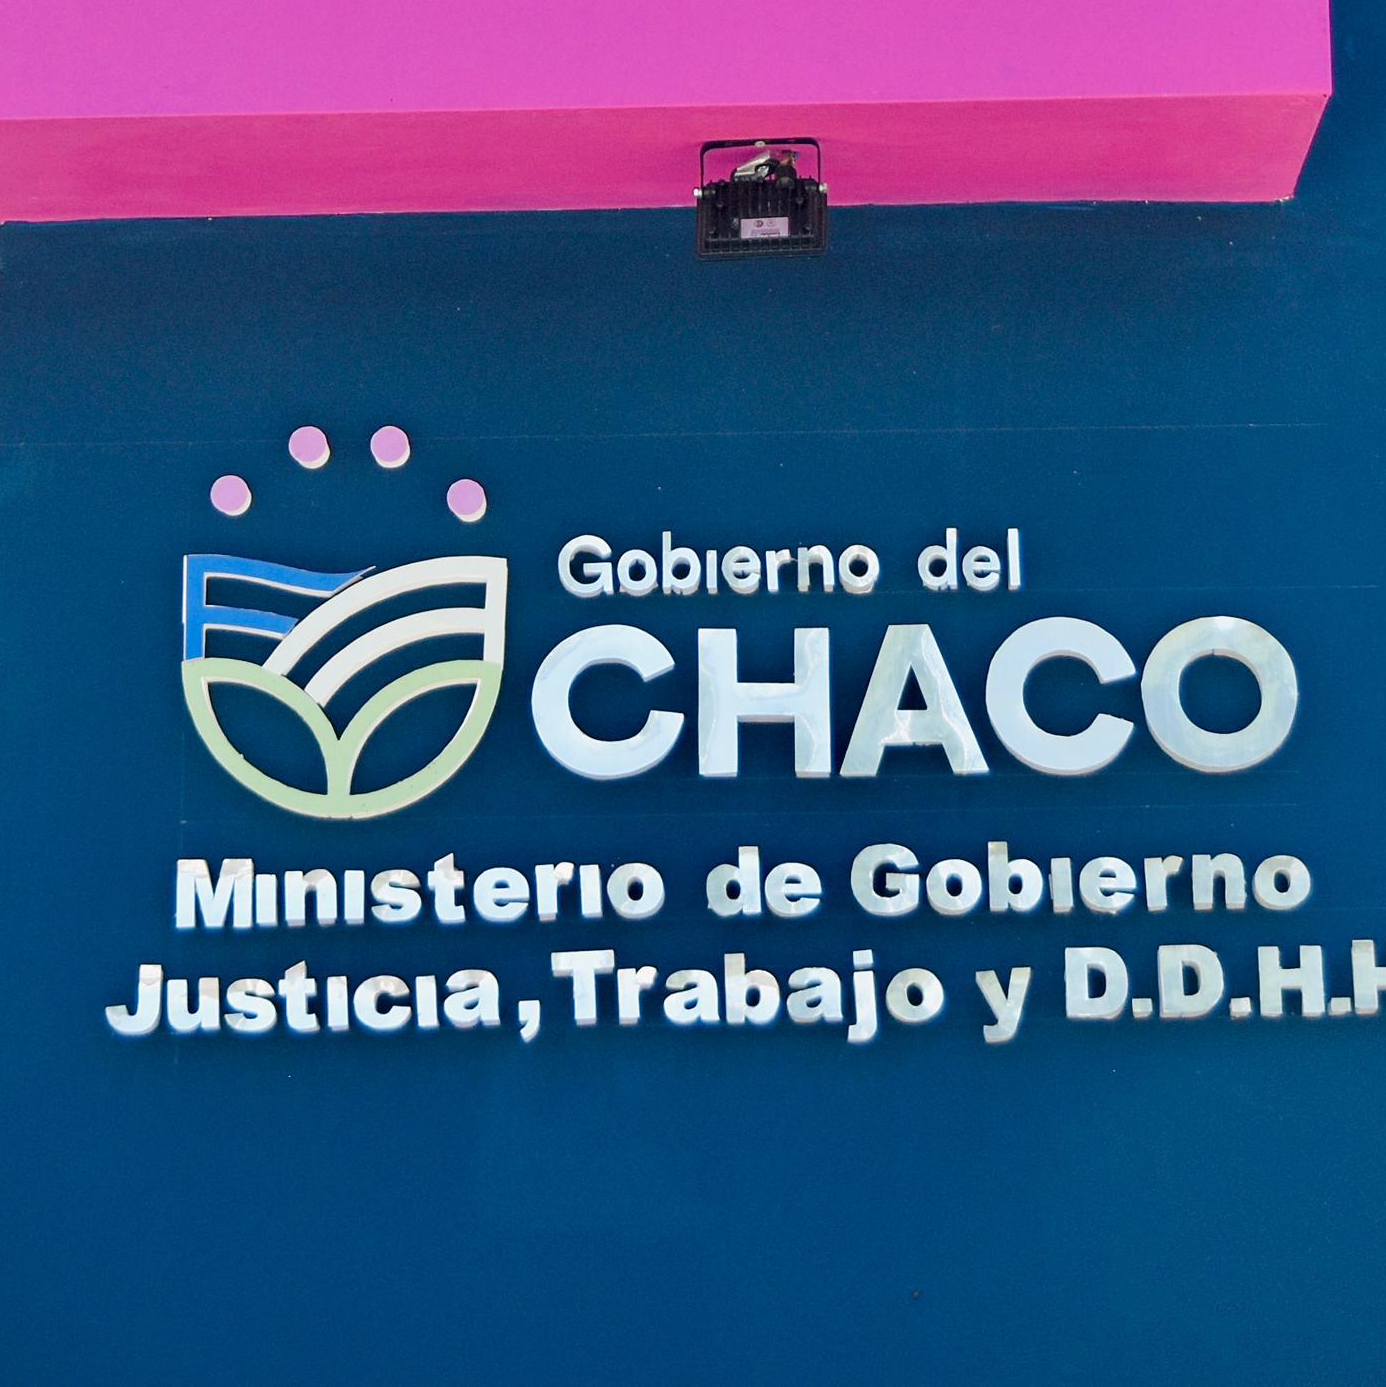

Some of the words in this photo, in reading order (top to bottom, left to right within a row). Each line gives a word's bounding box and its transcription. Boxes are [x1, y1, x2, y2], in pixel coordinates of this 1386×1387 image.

[917, 527, 1021, 592] del
[531, 615, 1299, 781] CHACO
[706, 845, 822, 918] de
[550, 949, 945, 1044] Trabajo
[975, 966, 1032, 1044] y
